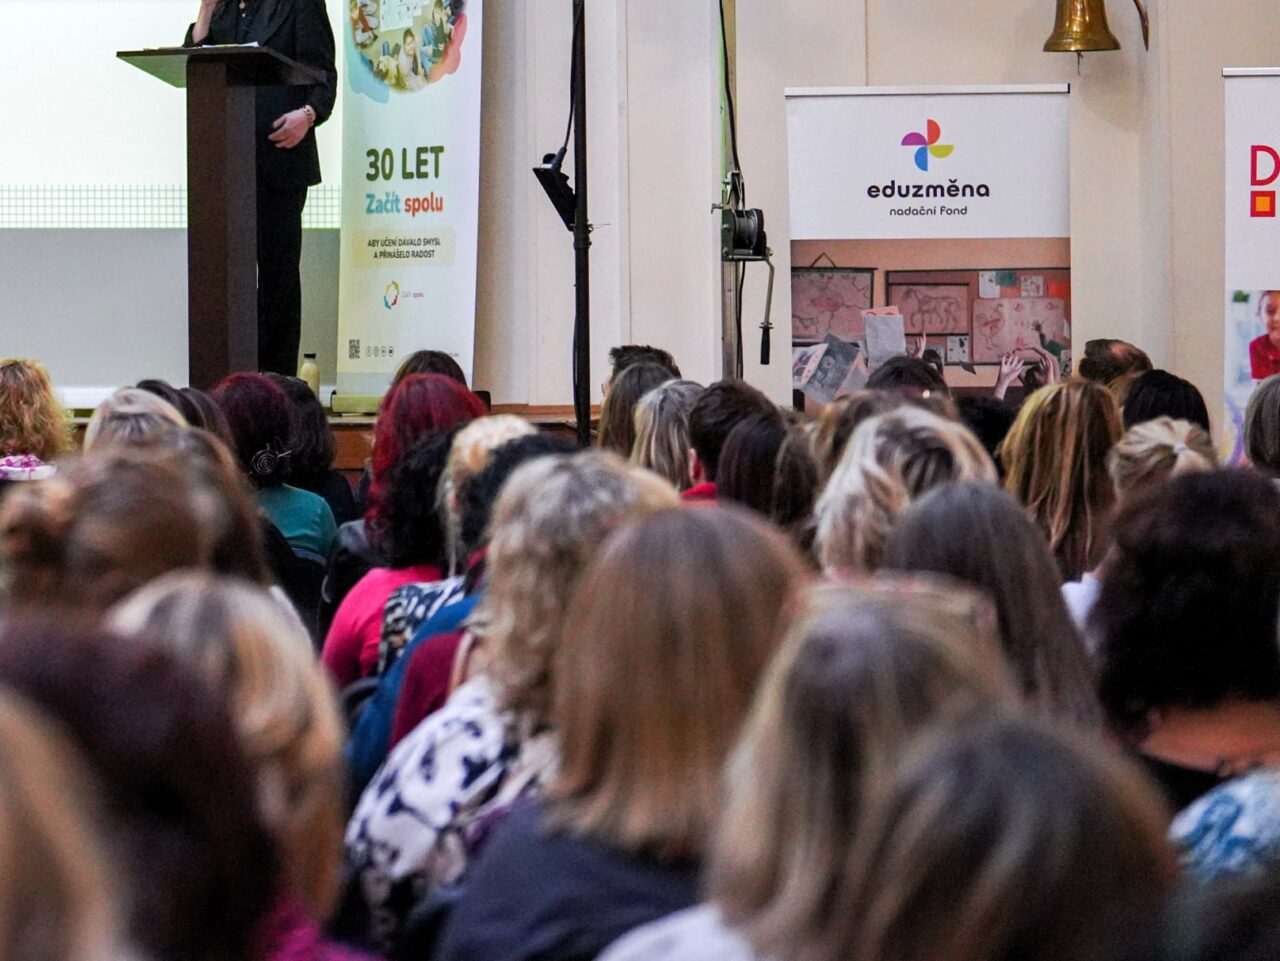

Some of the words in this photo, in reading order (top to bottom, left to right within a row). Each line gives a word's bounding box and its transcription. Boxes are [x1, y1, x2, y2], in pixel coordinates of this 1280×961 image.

[366, 147, 394, 181] 30
[401, 146, 444, 180] LET
[867, 178, 990, 198] eduzměna
[365, 191, 401, 214] Začít
[404, 191, 443, 217] spolu
[889, 206, 937, 216] nadační
[940, 205, 968, 215] fond
[367, 239, 380, 248] ABY
[380, 237, 397, 247] UČENÍ
[423, 237, 441, 246] SMYSL
[411, 249, 435, 258] RADOST
